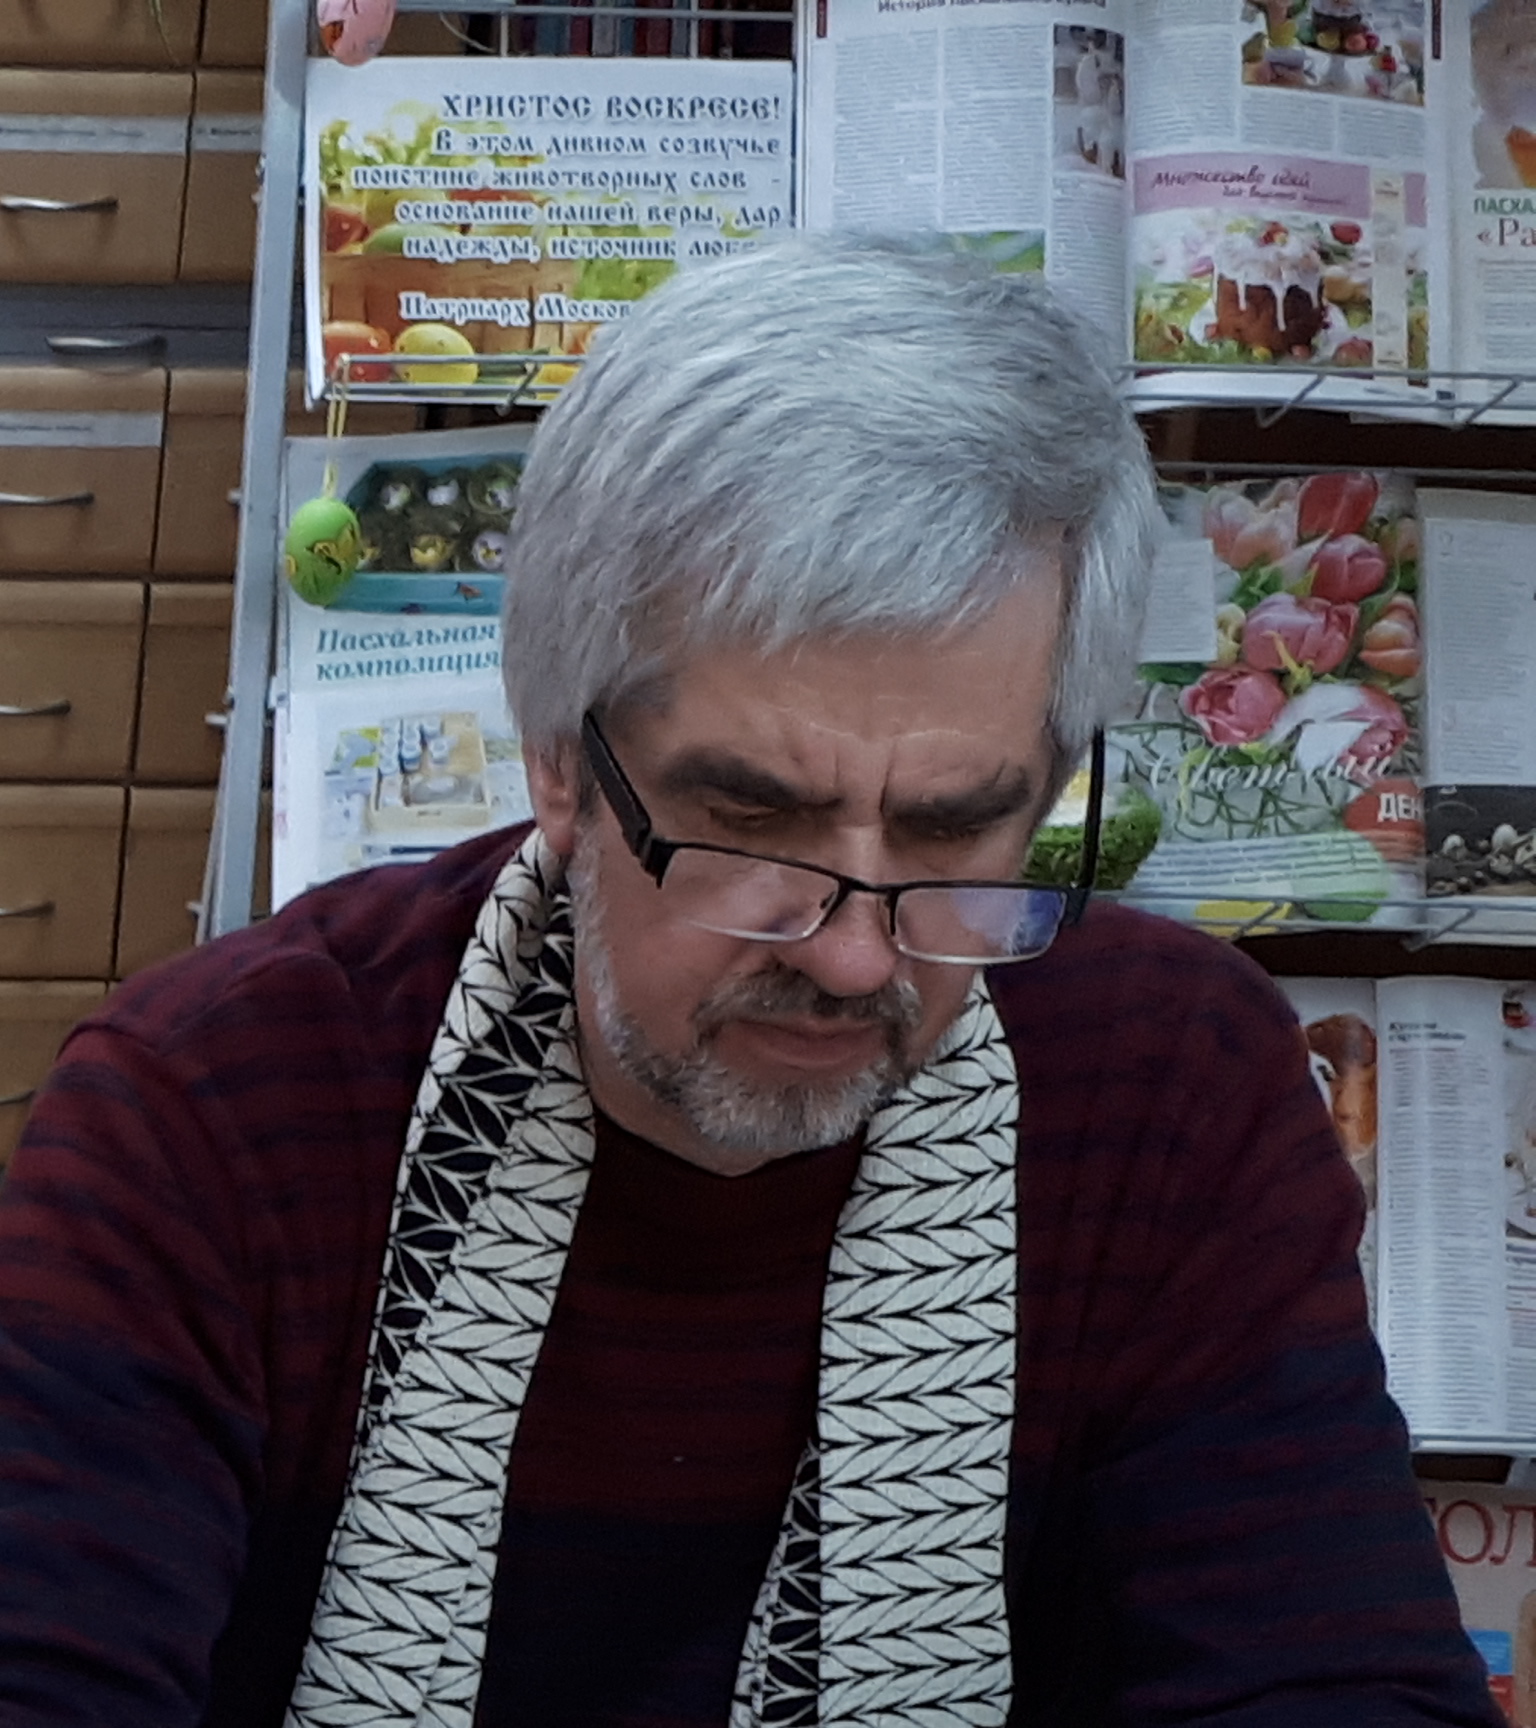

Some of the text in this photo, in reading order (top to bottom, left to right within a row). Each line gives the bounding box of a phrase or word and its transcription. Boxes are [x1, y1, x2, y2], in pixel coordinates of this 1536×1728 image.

[442, 94, 781, 120] ХРИСТОС ВОСКРЕСЕ!
[435, 128, 781, 159] В этом дивном созвучье
[353, 169, 480, 186] поистине
[492, 169, 678, 193] животворных
[689, 170, 748, 188] слов
[397, 200, 782, 227] основание нашей веры, дар
[1474, 197, 1536, 215] ПАСХА
[405, 238, 538, 261] надежды,
[551, 238, 677, 257] источник
[404, 296, 527, 323] Патриарх
[316, 622, 499, 654] Пасхальная
[316, 650, 500, 681] композиция
[1423, 1497, 1536, 1568] ОЛ
